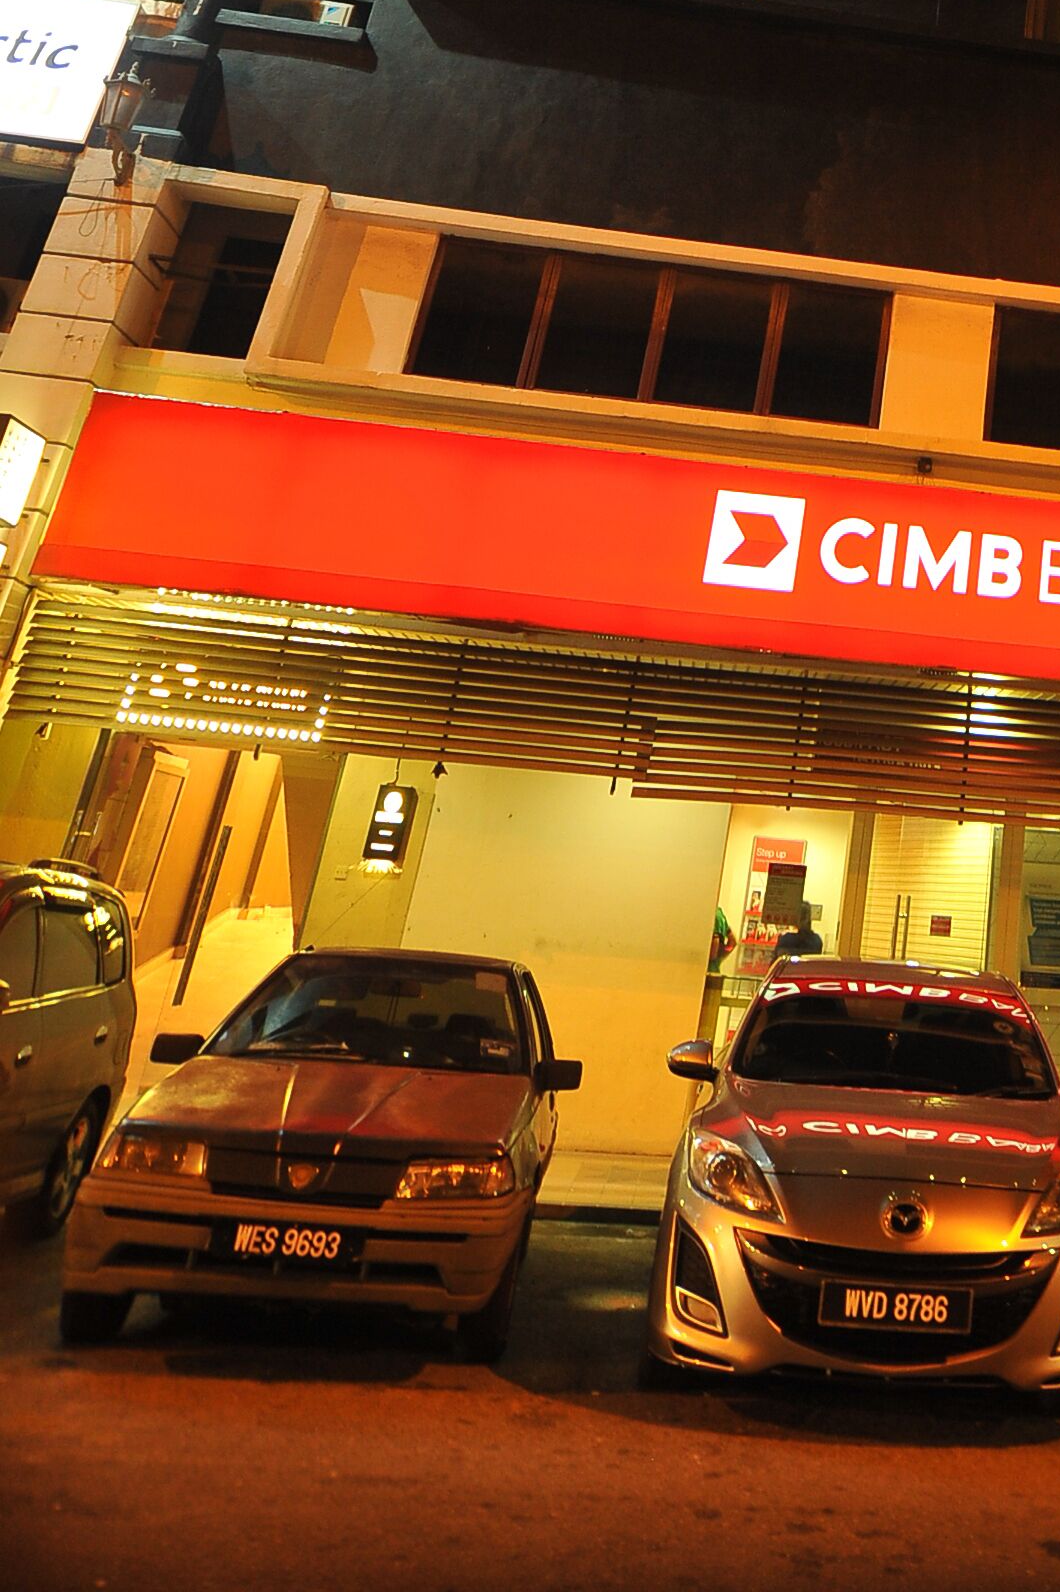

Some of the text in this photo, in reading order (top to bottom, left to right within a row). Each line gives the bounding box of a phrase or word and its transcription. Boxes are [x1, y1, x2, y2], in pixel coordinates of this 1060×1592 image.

[819, 516, 1023, 599] CIMB
[756, 847, 787, 860] Step up
[234, 1223, 341, 1259] WES 9693
[845, 1288, 949, 1323] WVD 8786
